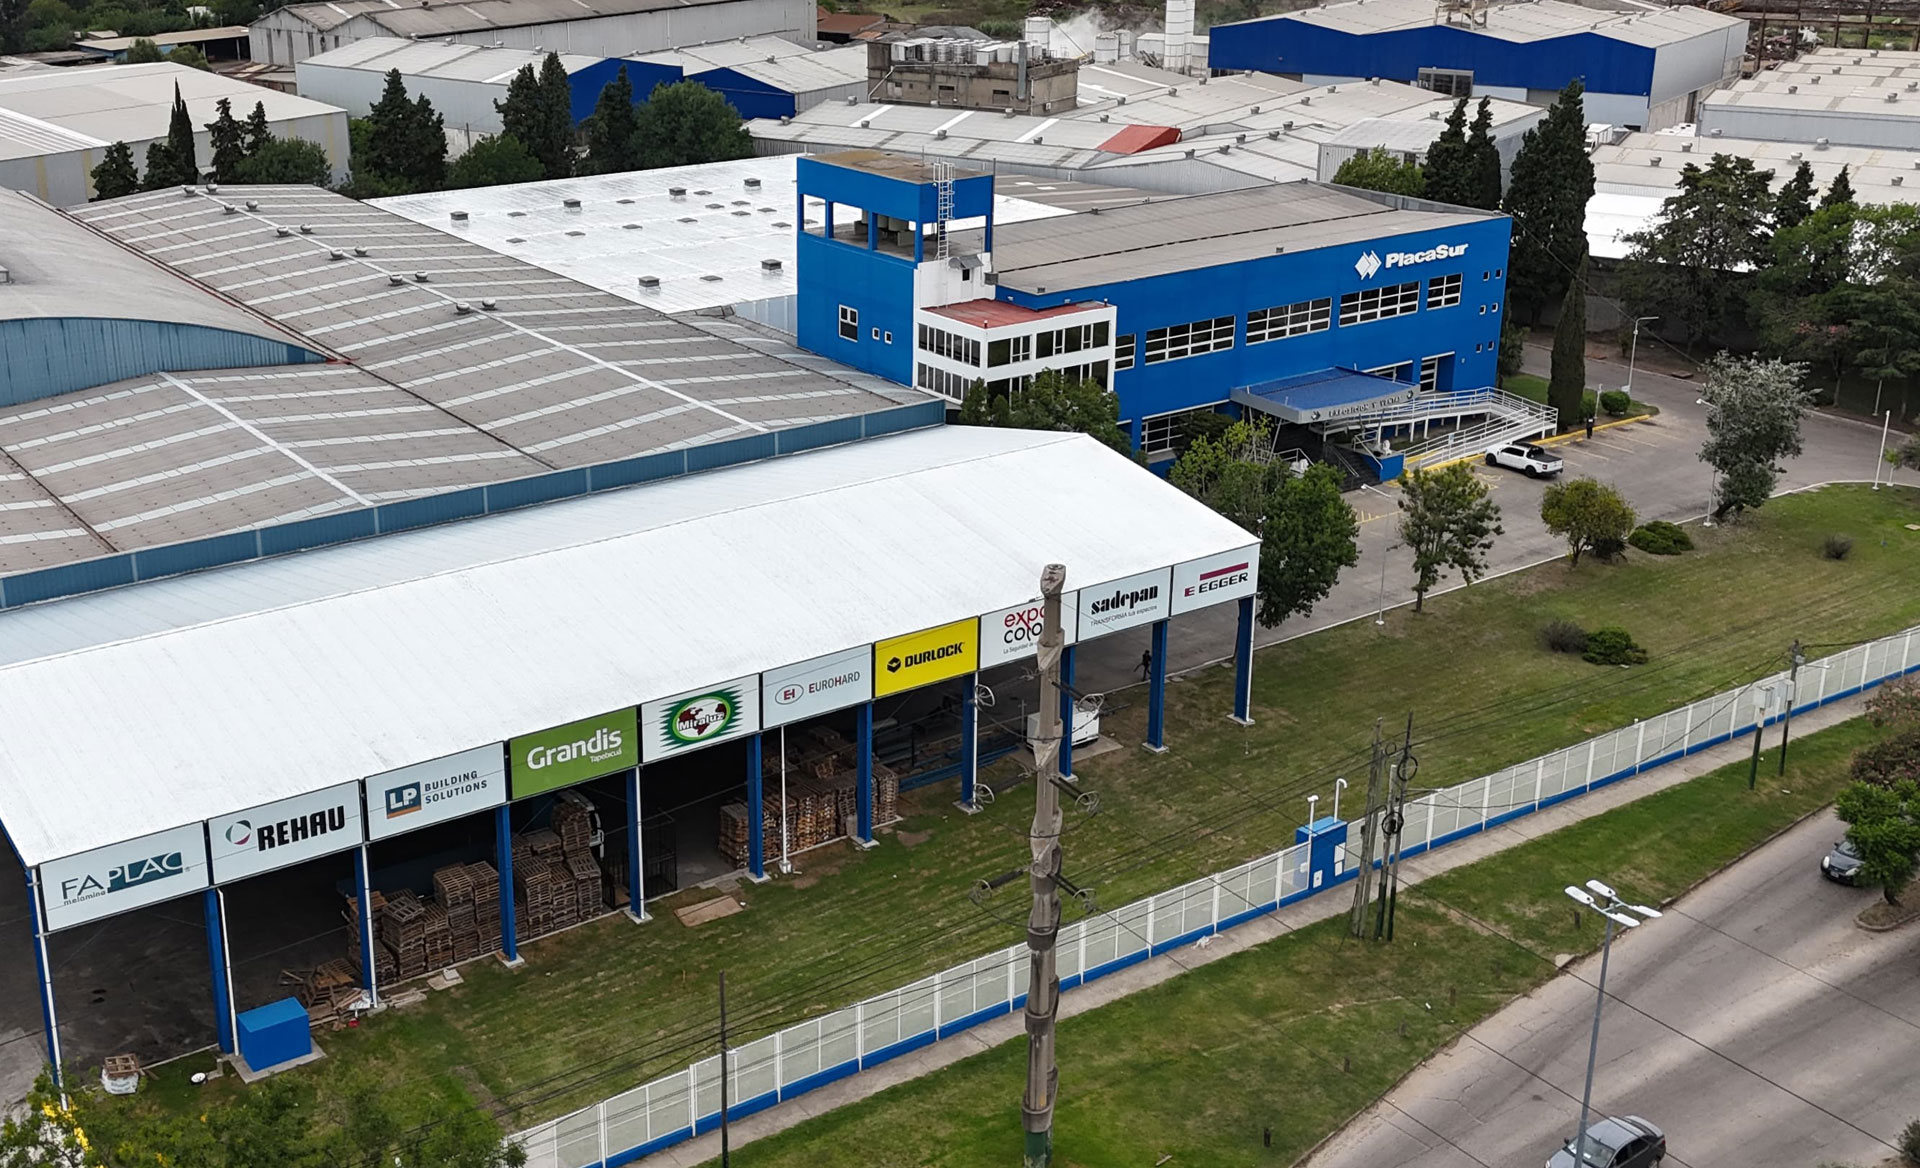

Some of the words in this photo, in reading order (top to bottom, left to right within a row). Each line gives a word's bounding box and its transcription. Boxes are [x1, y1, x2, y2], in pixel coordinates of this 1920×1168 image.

[1385, 243, 1469, 269] PlacaSur
[1198, 572, 1249, 594] EGGER
[1091, 585, 1158, 615] sadepan
[1004, 622, 1043, 644] colo
[904, 641, 963, 668] DURLOCK
[808, 671, 861, 694] EUROHARD
[678, 712, 725, 731] Miraluz
[527, 728, 622, 770] Grandis
[424, 770, 478, 792] BUILDING
[425, 780, 488, 804] SOLUTIONS
[389, 787, 418, 810] LP
[257, 805, 345, 852] REHAU
[61, 851, 183, 900] FAPLAC
[64, 890, 106, 906] melamina
